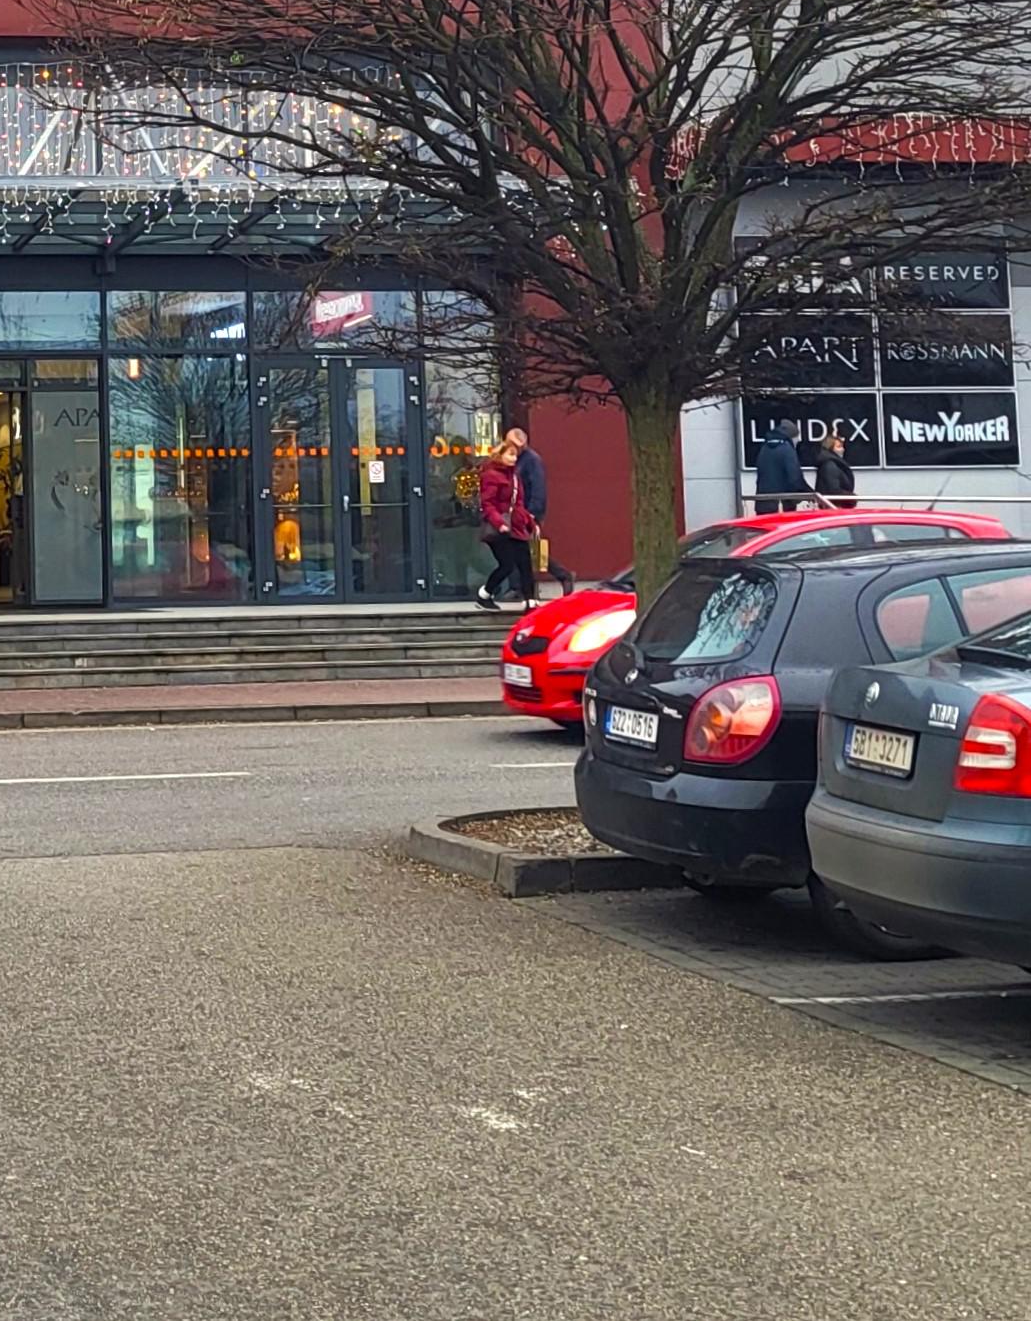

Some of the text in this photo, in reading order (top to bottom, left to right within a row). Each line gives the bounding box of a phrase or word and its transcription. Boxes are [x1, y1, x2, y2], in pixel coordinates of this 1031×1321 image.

[883, 265, 1000, 281] RESERVED
[751, 336, 864, 371] APART
[886, 341, 1009, 366] ROSSMANN
[879, 735, 909, 767] 3271
